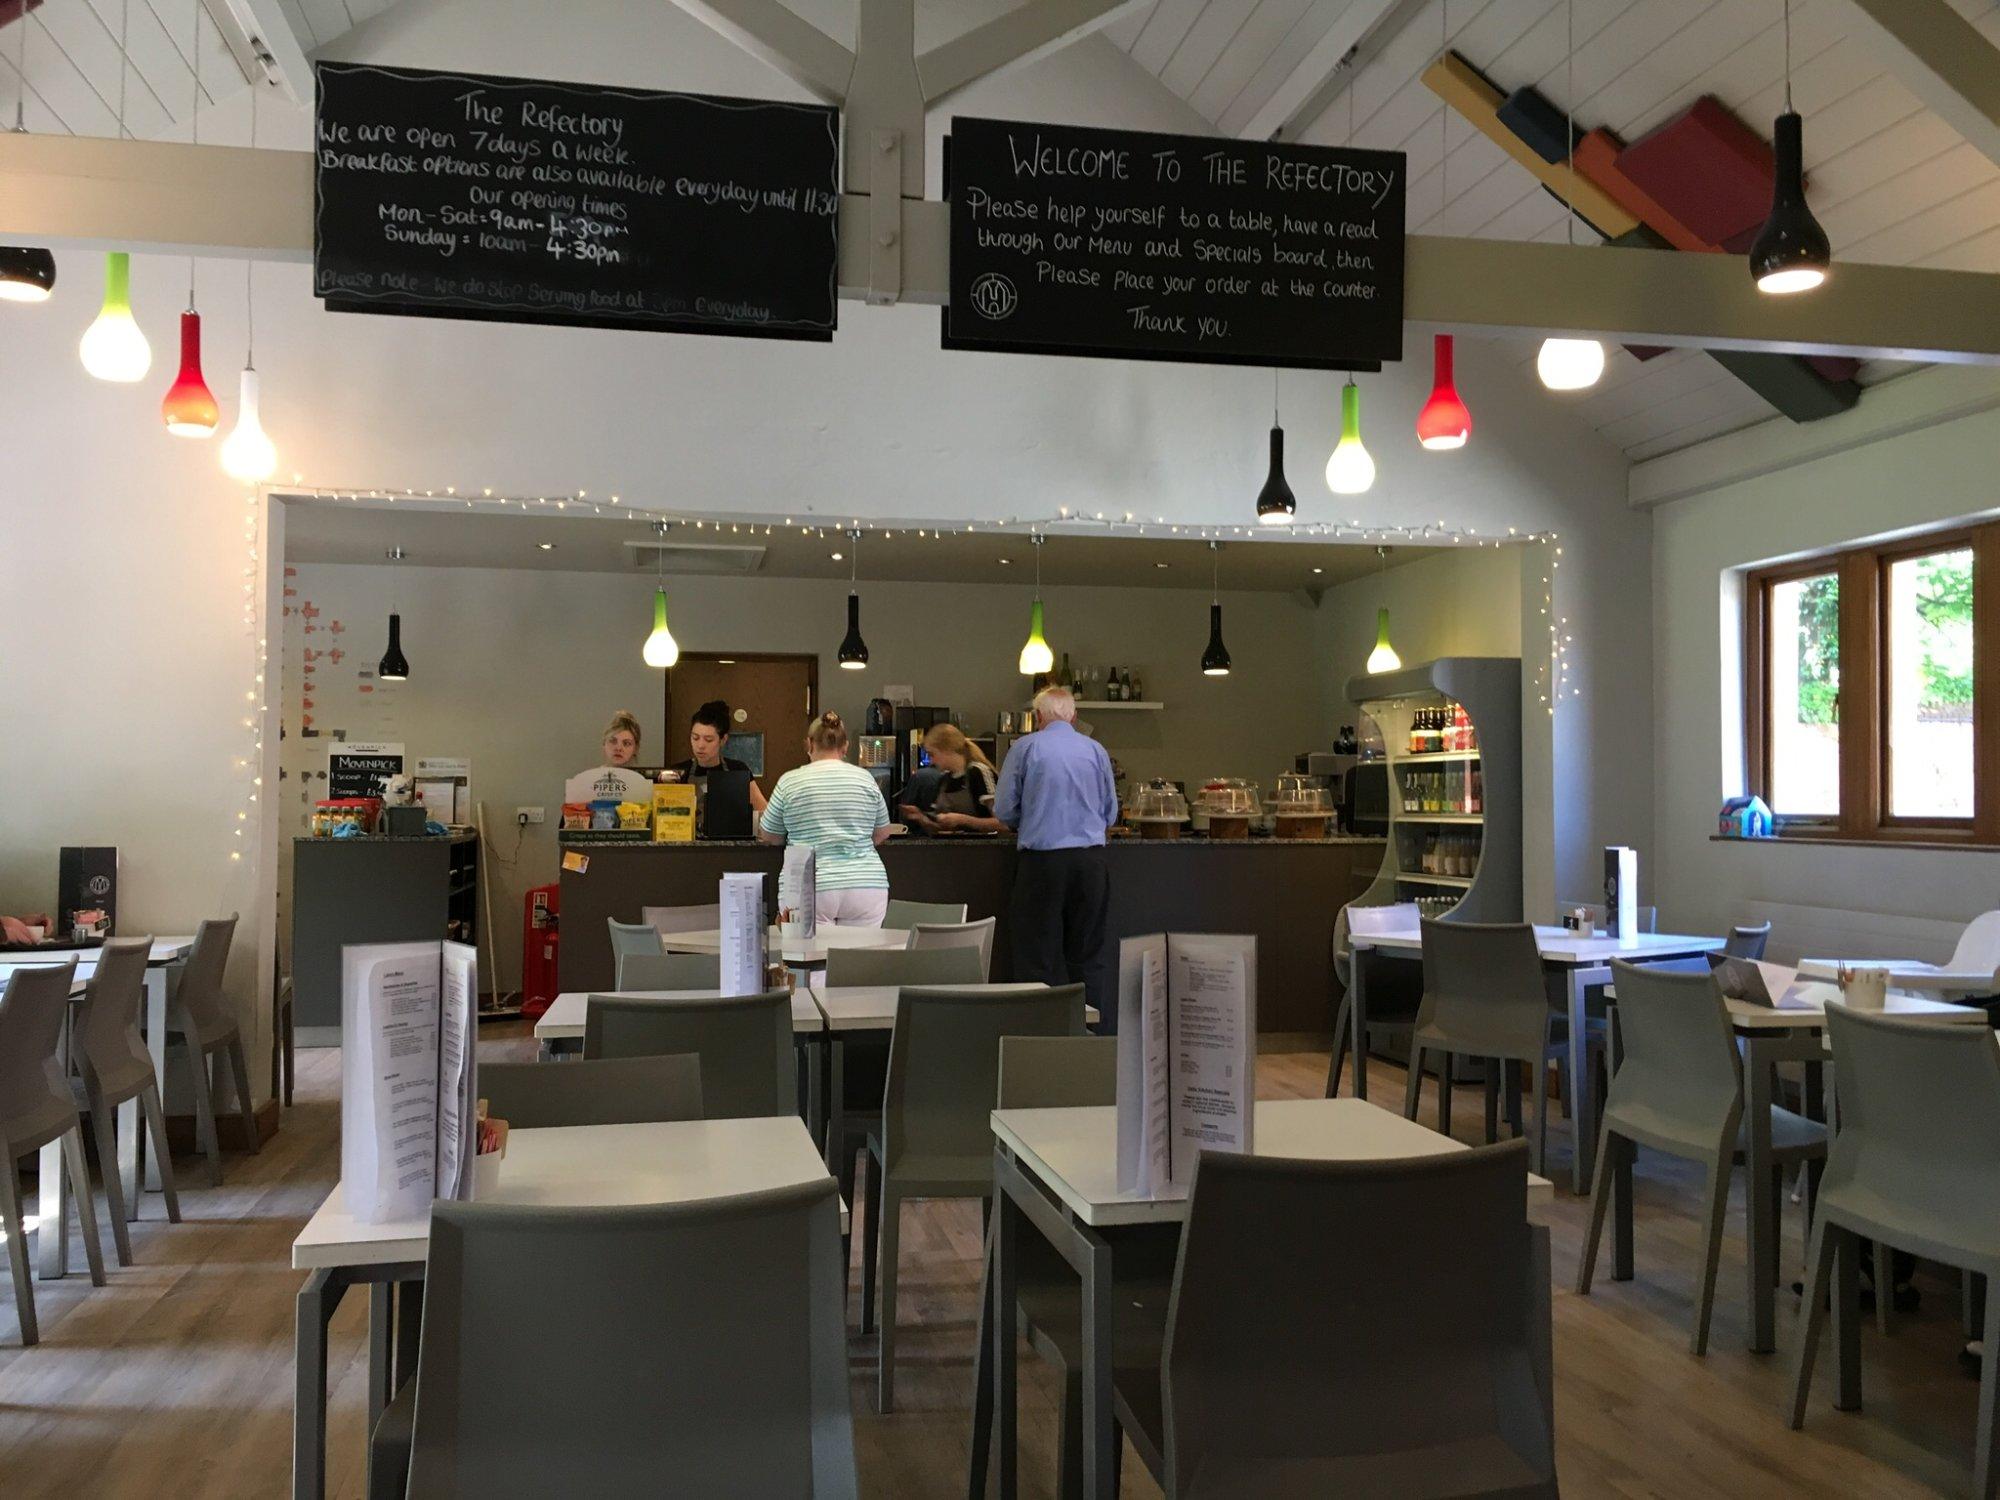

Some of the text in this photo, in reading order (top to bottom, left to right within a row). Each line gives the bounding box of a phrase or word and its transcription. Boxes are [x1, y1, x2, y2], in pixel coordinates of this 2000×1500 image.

[319, 118, 351, 143] We
[358, 124, 396, 143] are
[406, 128, 455, 148] open
[455, 90, 623, 147] The Refectory
[321, 150, 417, 173] Breakfast
[423, 157, 489, 177] options
[496, 164, 525, 180] are
[532, 165, 572, 183] also
[577, 168, 665, 195] available
[763, 188, 796, 211] until
[1008, 134, 1130, 180] WELCOME
[1202, 151, 1247, 186] THE
[1266, 155, 1394, 210] REFECTORY
[470, 186, 628, 221] Our opening times
[966, 186, 1379, 239] Please help yourself to a table, have a read
[384, 224, 456, 256] Sunday
[978, 227, 1044, 255] through
[1053, 232, 1082, 251] Our
[1145, 238, 1182, 258] and
[1193, 239, 1262, 264] Specials
[321, 269, 373, 288] Please
[463, 277, 484, 294] do
[626, 291, 645, 309] at
[1036, 260, 1101, 287] Please
[1162, 275, 1196, 296] your
[1205, 279, 1251, 295] order
[1261, 278, 1279, 297] at
[1290, 279, 1315, 297] the
[1127, 305, 1187, 334] Thank
[593, 783, 627, 792] PIPERS
